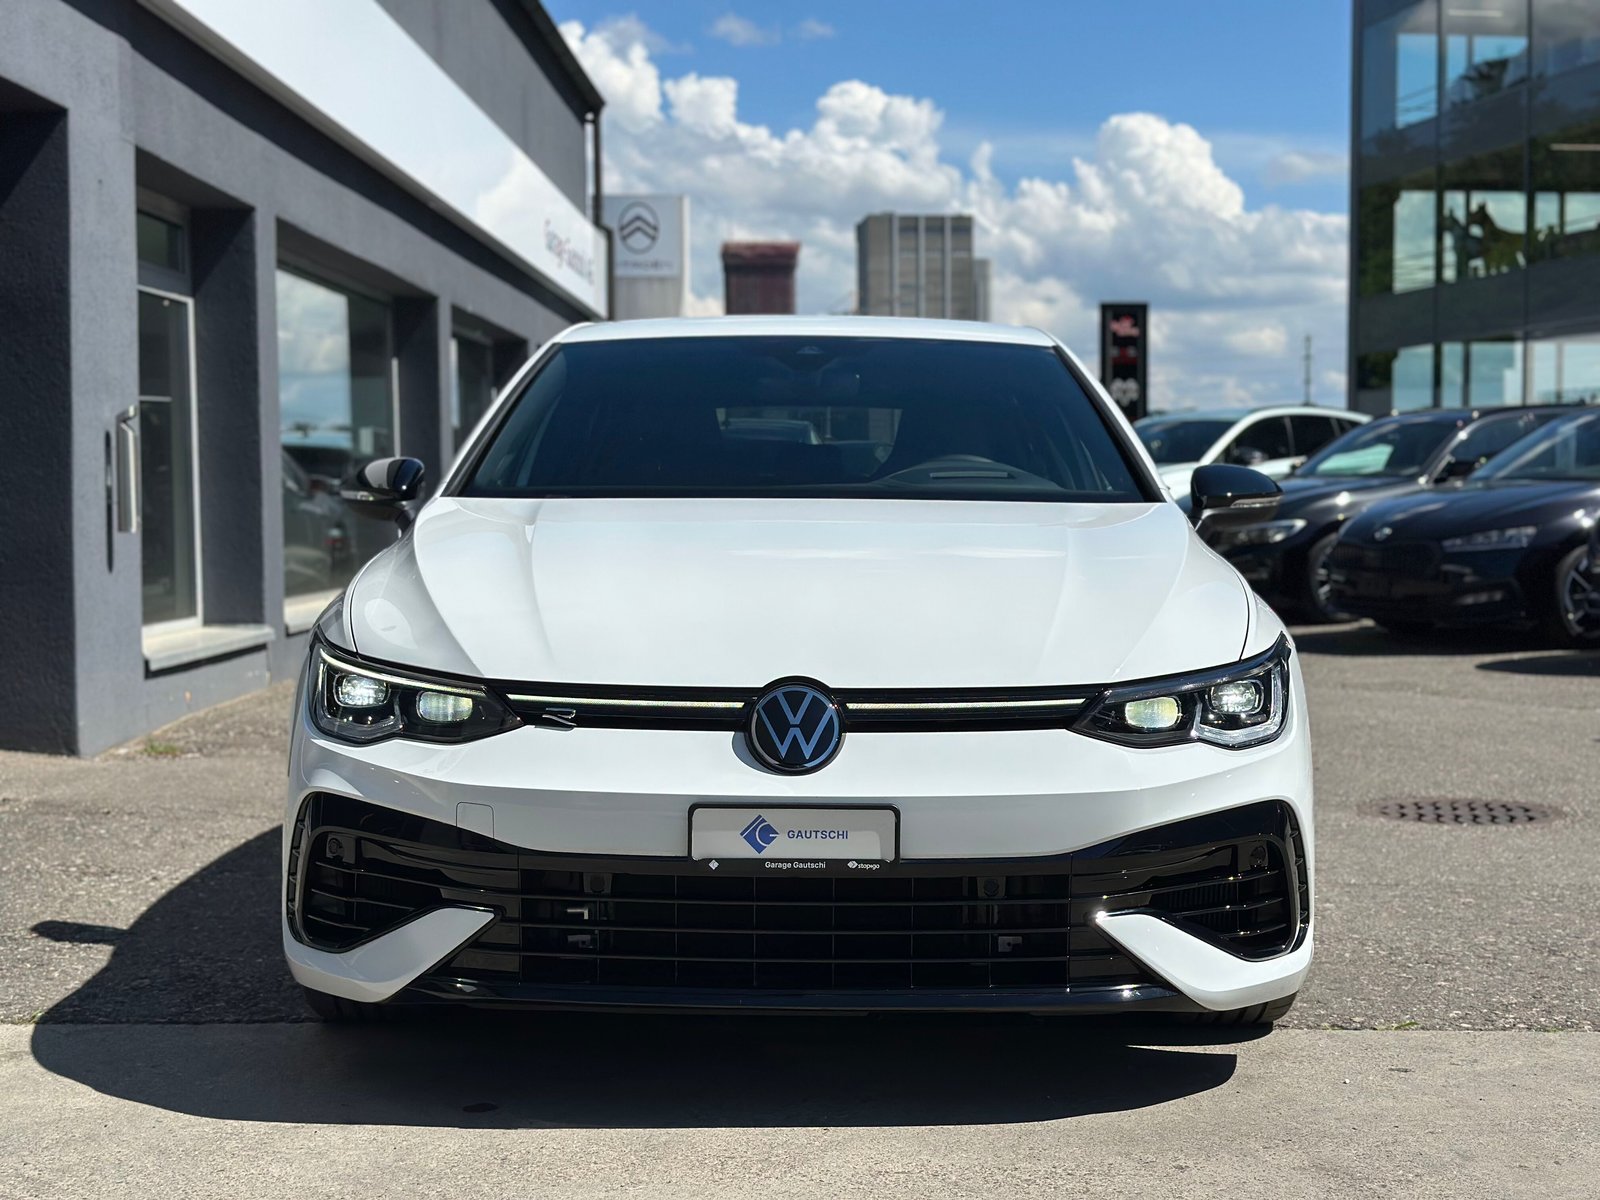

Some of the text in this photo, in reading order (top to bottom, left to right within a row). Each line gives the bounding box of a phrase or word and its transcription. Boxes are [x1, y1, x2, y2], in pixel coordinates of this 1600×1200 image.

[787, 829, 848, 840] GAUTSCHI
[764, 861, 826, 870] Garage Gautschi
